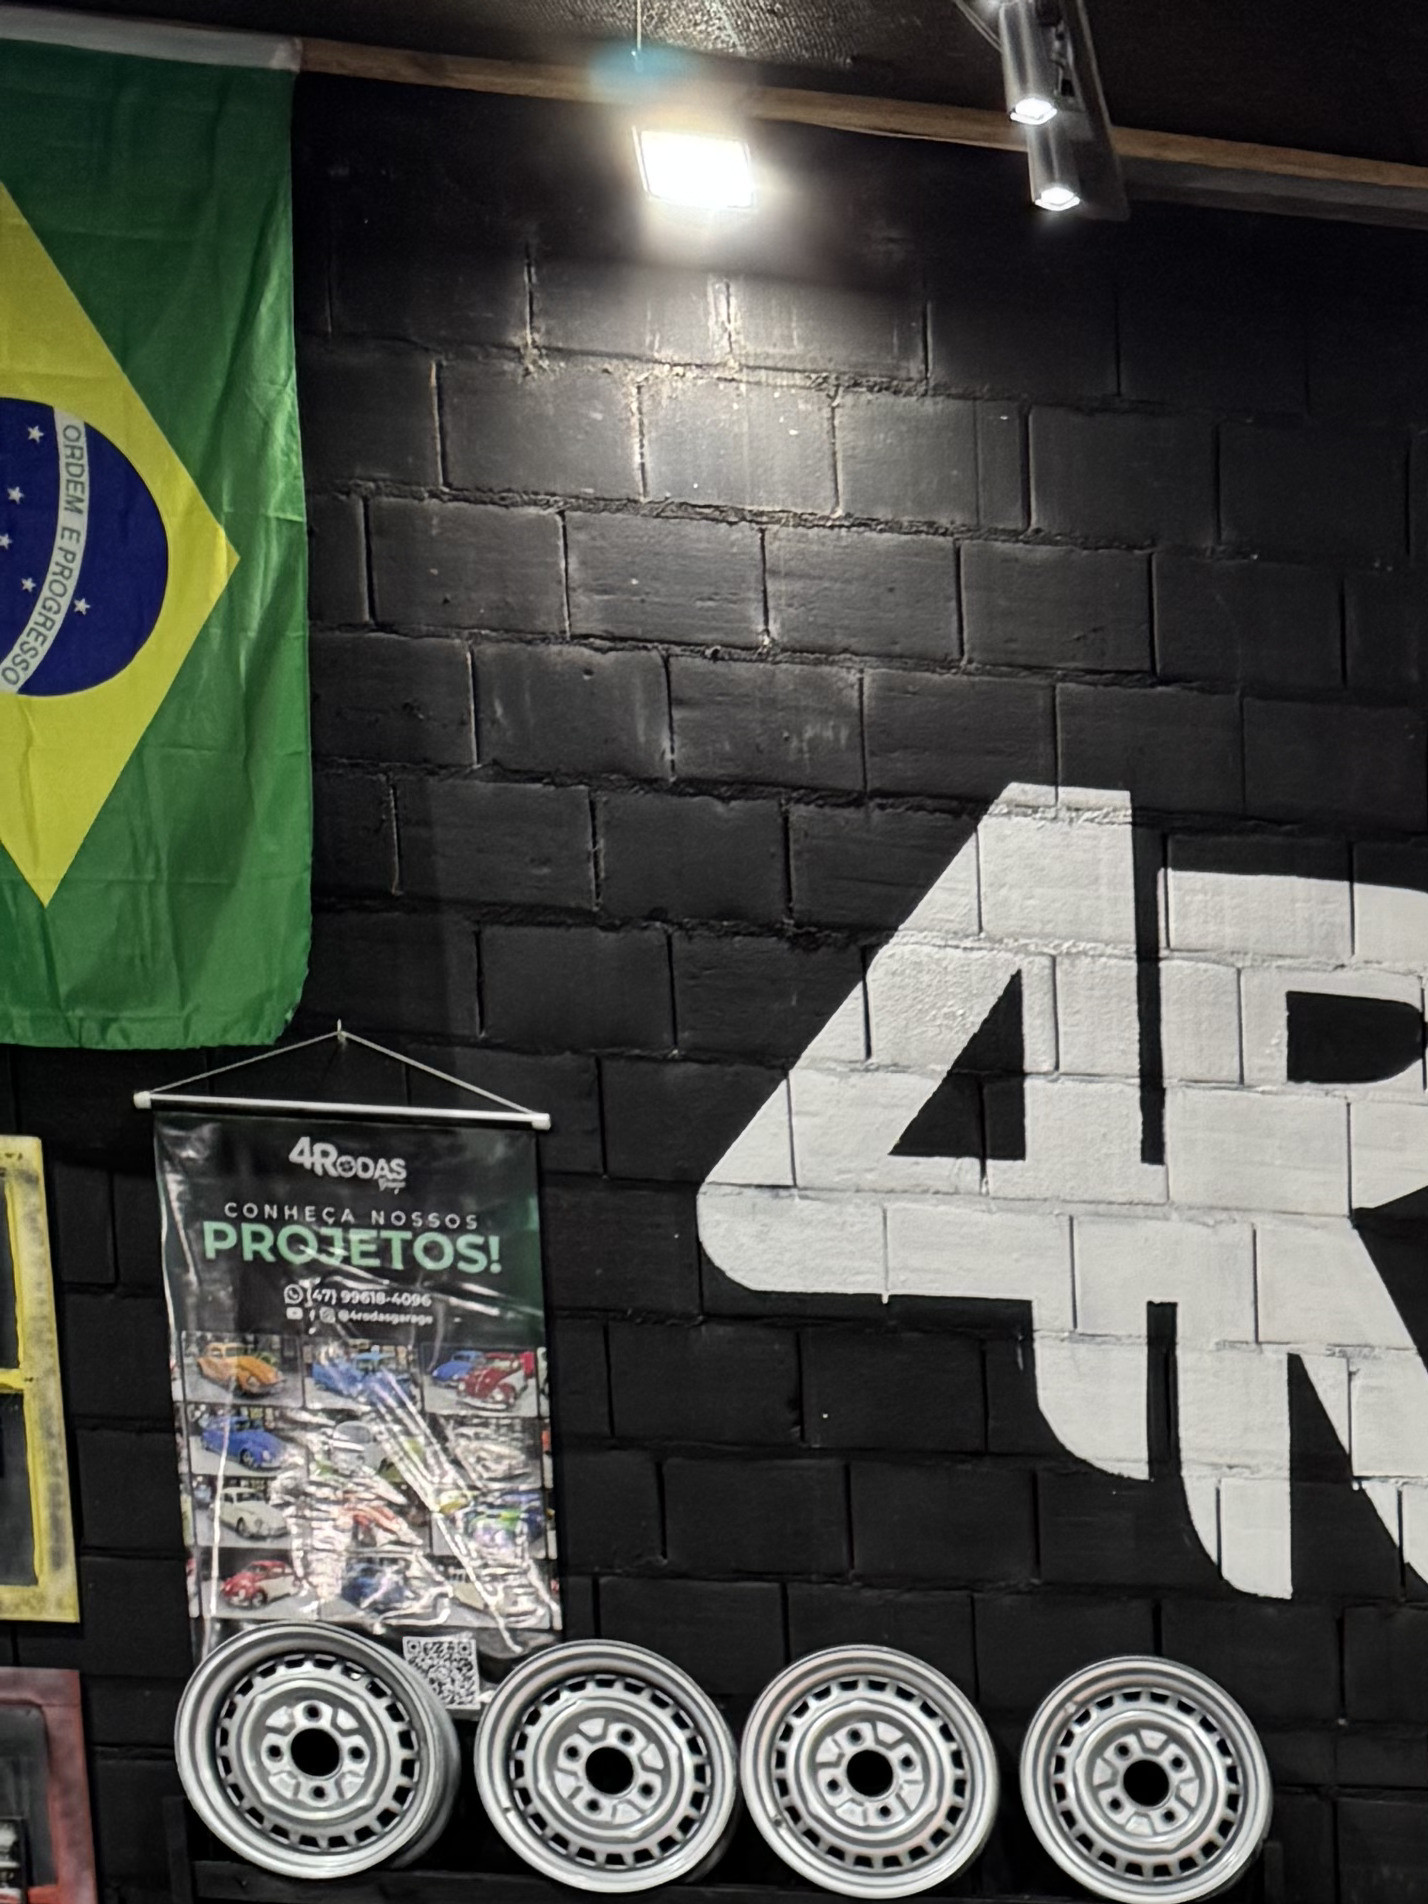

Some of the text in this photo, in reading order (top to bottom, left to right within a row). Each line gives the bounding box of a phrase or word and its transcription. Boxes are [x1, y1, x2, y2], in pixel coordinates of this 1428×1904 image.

[0, 423, 87, 687] ORDEM E PROGRESSO
[224, 1202, 478, 1230] CONHEÇA NOSSOS
[202, 1220, 502, 1274] PROJETOS!
